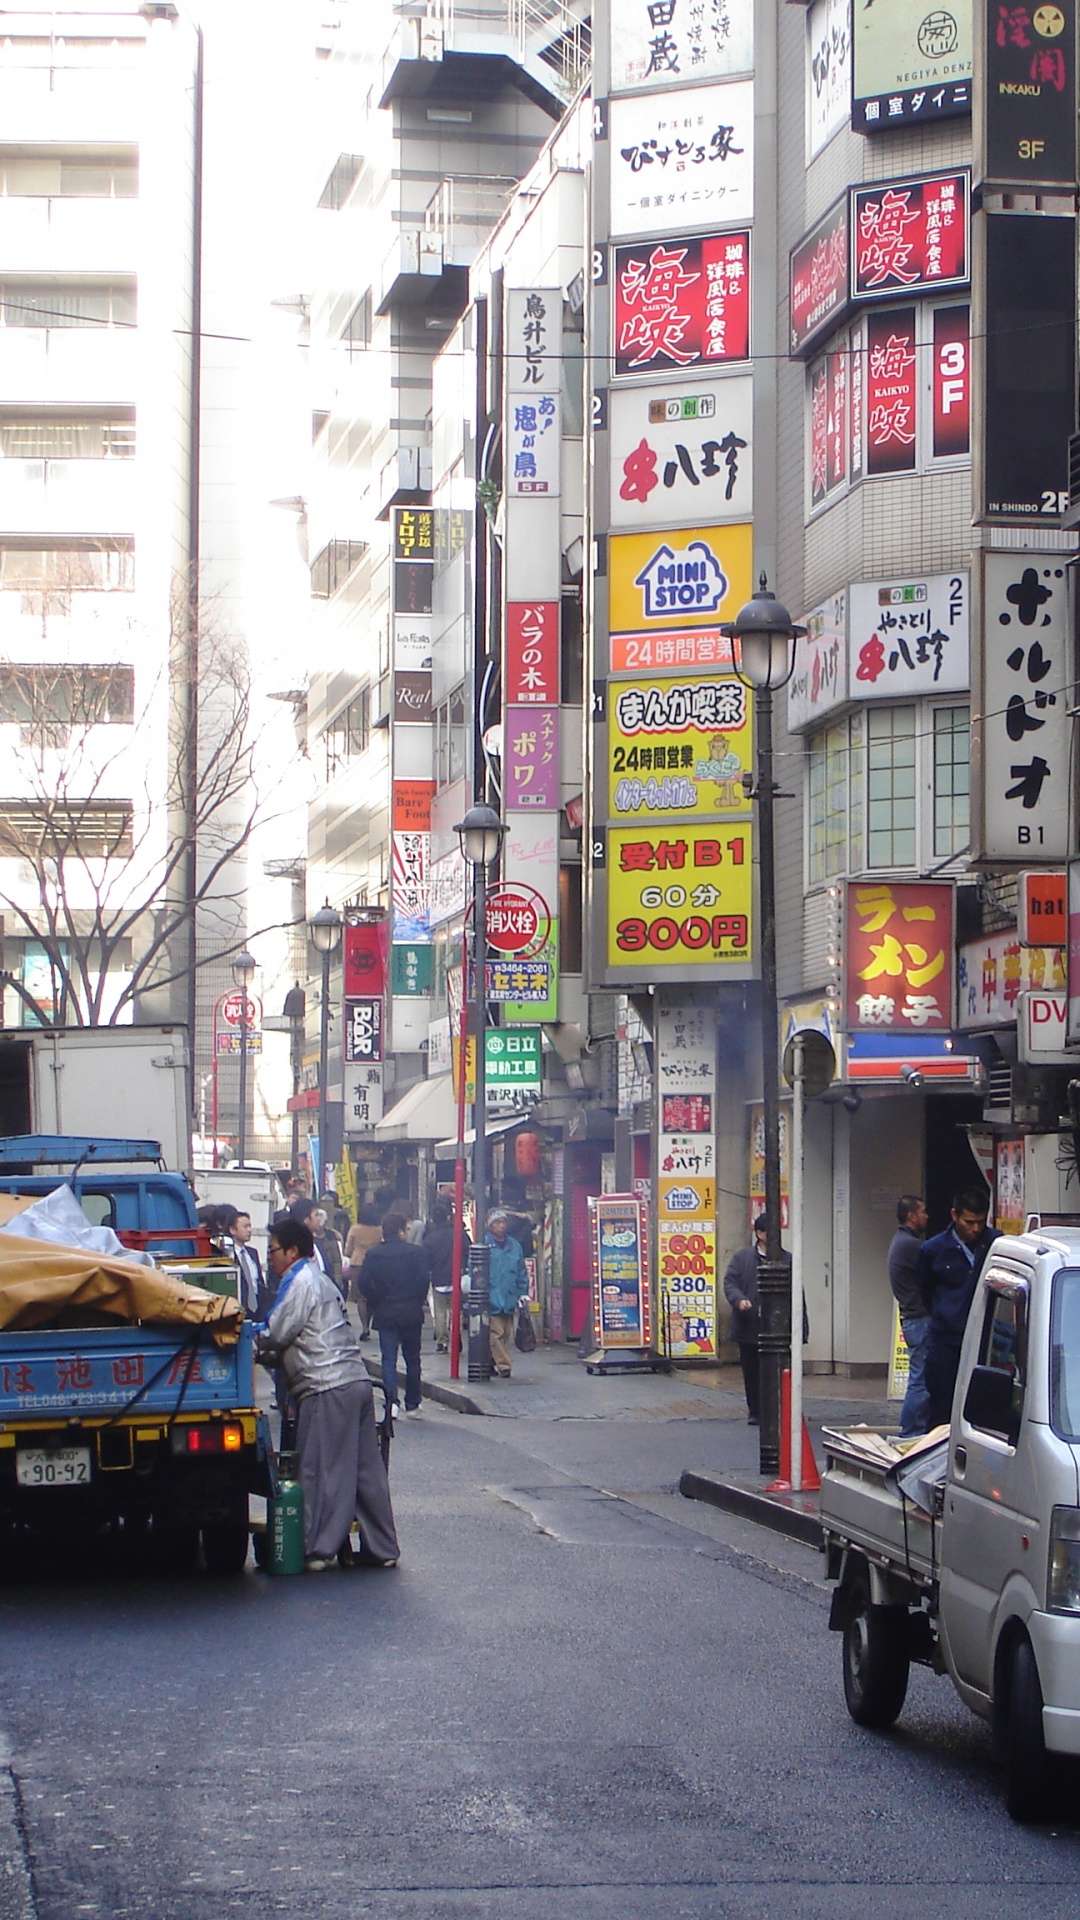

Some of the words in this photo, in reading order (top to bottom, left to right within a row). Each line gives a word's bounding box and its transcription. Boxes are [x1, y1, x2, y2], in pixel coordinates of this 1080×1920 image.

[896, 68, 938, 83] NEGIYA
[865, 87, 968, 121] 個室ダイニ
[1018, 140, 1045, 159] 3F
[620, 245, 700, 367] 海峡
[642, 302, 671, 312] KAIKYO
[706, 261, 727, 356] 洋風居食屋
[939, 342, 965, 414] 3F
[874, 384, 910, 398] KAIKYO
[1001, 503, 1038, 513] SHINDO
[399, 511, 415, 556] トロワー
[657, 562, 706, 585] MINI
[655, 585, 709, 608] STOP
[949, 578, 963, 625] 2F
[518, 605, 546, 690] バラの木
[625, 636, 733, 667] 24時間営業
[396, 687, 431, 710] Real
[619, 684, 743, 728] まんが喫茶
[540, 713, 554, 765] スナック
[613, 744, 693, 772] 24時間営業
[397, 797, 423, 807] Bare
[1018, 826, 1045, 844] B1
[619, 837, 744, 872] 受付B1
[640, 884, 720, 908] 60分
[486, 910, 534, 934] 消火栓
[616, 915, 748, 951] 300円
[493, 972, 548, 990] セキネ
[855, 993, 943, 1027] 餃子
[354, 1007, 373, 1054] BAR
[507, 1036, 536, 1052] 日立
[486, 1061, 536, 1075] 電動工具
[353, 1084, 370, 1120] 有明
[705, 1187, 712, 1209] 1F
[671, 1277, 713, 1293] 380円
[689, 1327, 714, 1338] B1F
[33, 1463, 87, 1482] 90-92
